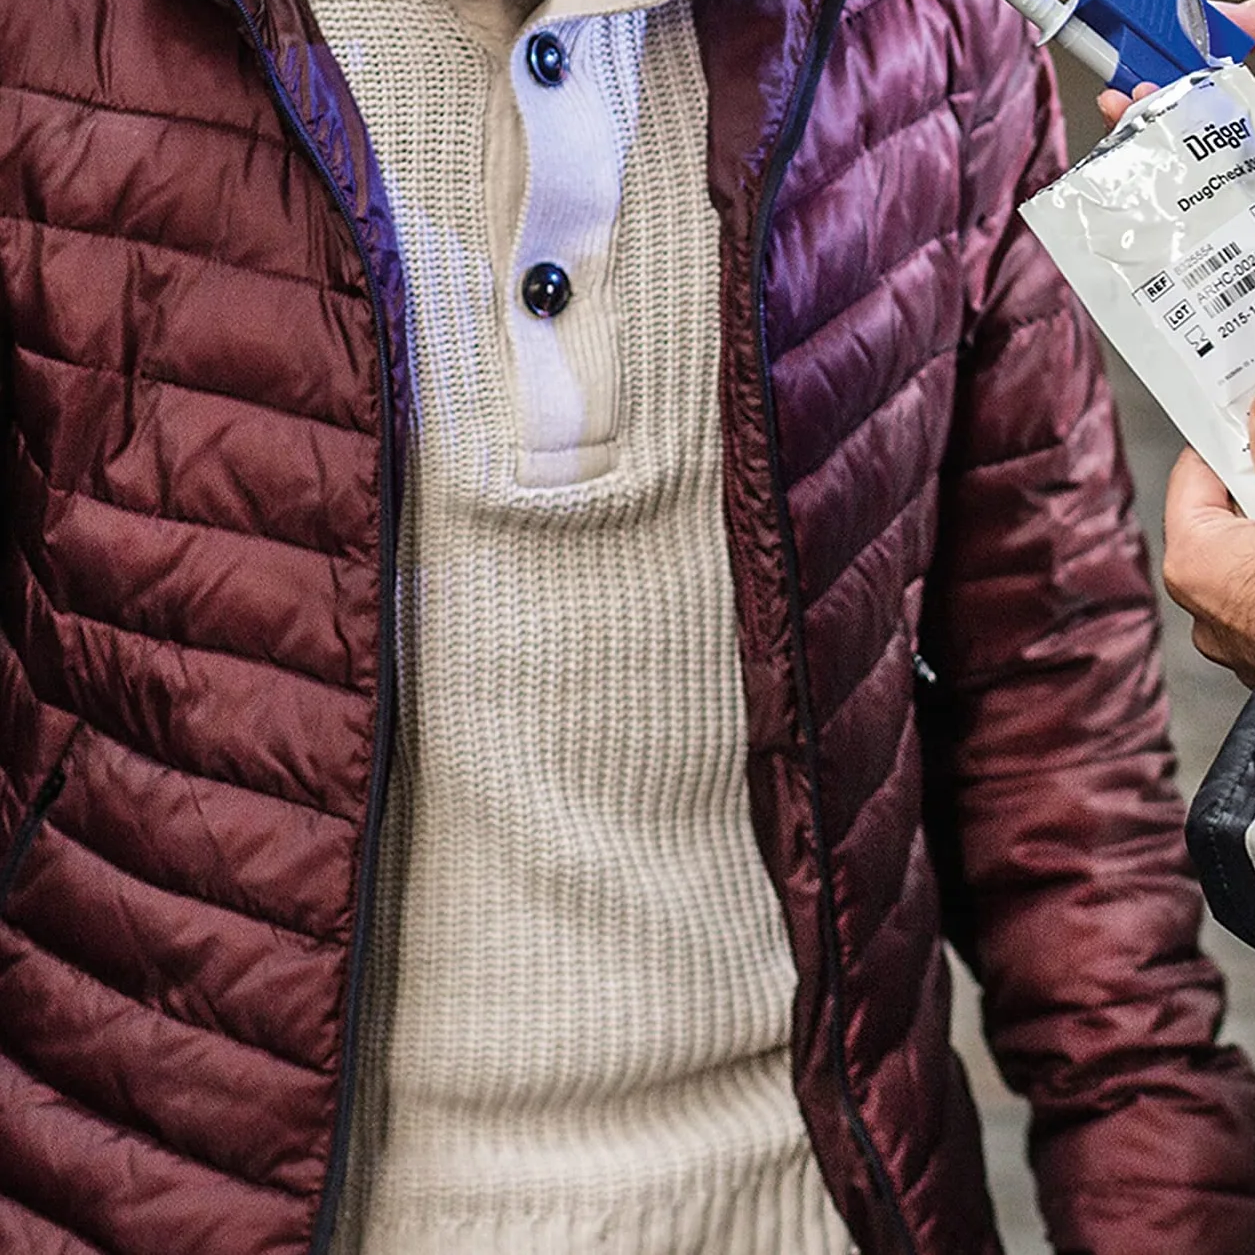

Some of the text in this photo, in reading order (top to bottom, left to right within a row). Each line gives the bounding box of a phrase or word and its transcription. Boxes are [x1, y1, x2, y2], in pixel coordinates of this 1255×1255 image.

[1182, 117, 1251, 162] Dräger
[1177, 163, 1247, 212] DrugCheck
[1147, 276, 1169, 298] REF
[1168, 304, 1190, 326] LOT
